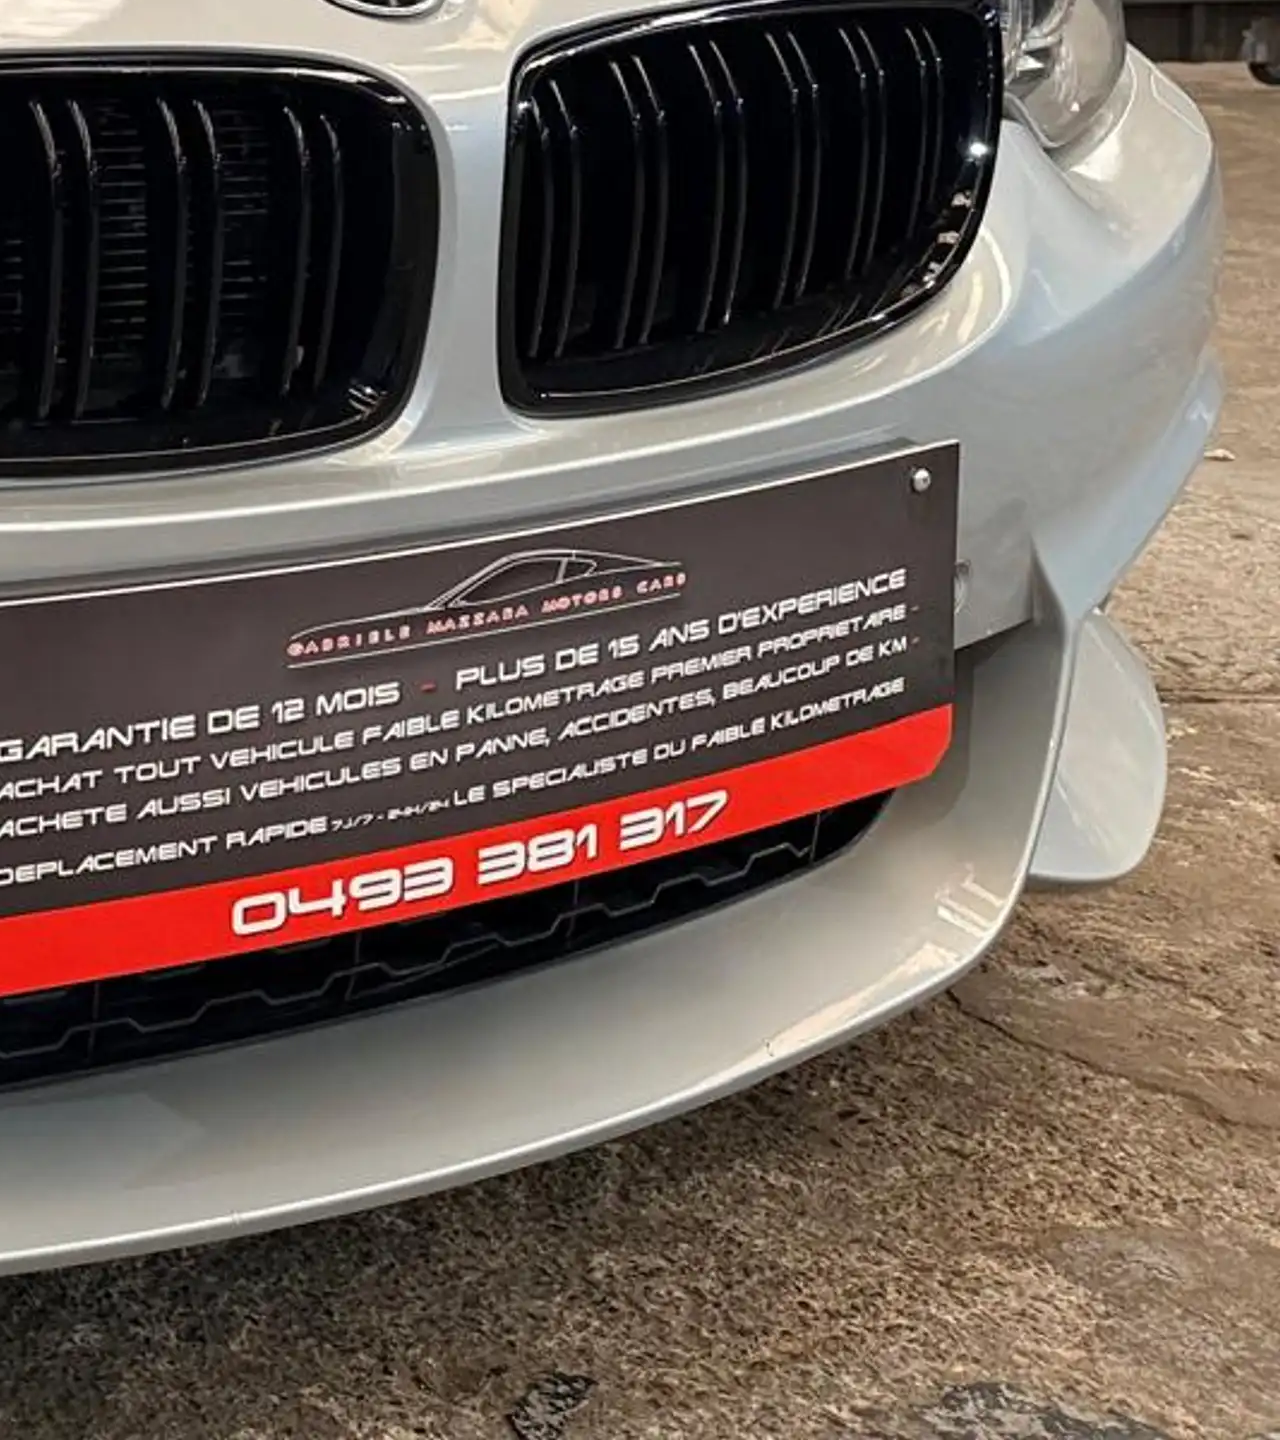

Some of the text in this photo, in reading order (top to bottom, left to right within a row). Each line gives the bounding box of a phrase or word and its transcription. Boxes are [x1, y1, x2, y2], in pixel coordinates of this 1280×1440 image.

[114, 756, 202, 784] TOUT
[210, 731, 355, 769] VEHICULE
[362, 710, 460, 745] FAIBLE
[466, 671, 645, 725] KILOMETRAGE
[650, 646, 752, 684] PREMIER
[757, 605, 907, 657] PROPRIETAIRE
[137, 787, 230, 819] AUSSI
[240, 758, 402, 802] VEHICULES
[409, 749, 448, 771] EN
[456, 728, 551, 762] PANNE,
[558, 688, 716, 740] ACCIDENTES,
[722, 656, 840, 701] BEAUCOUP
[846, 646, 874, 667] DE
[879, 637, 907, 657] KM
[207, 705, 260, 735] DE
[272, 698, 305, 724] 12
[316, 682, 400, 716] MOIS
[456, 655, 545, 690] PLUS
[555, 644, 599, 672] DE
[609, 633, 640, 661] 15
[649, 618, 710, 652] ANS
[718, 568, 907, 635] D'EXPERIENCE
[226, 816, 328, 849] RAPIDE
[454, 784, 486, 806] LE
[492, 748, 648, 798] SPECIALISTE
[653, 740, 686, 761] DU
[691, 718, 765, 752] FAIBLE
[770, 677, 906, 731] KILOMETRAGE
[232, 789, 729, 936] 0493 381 317
